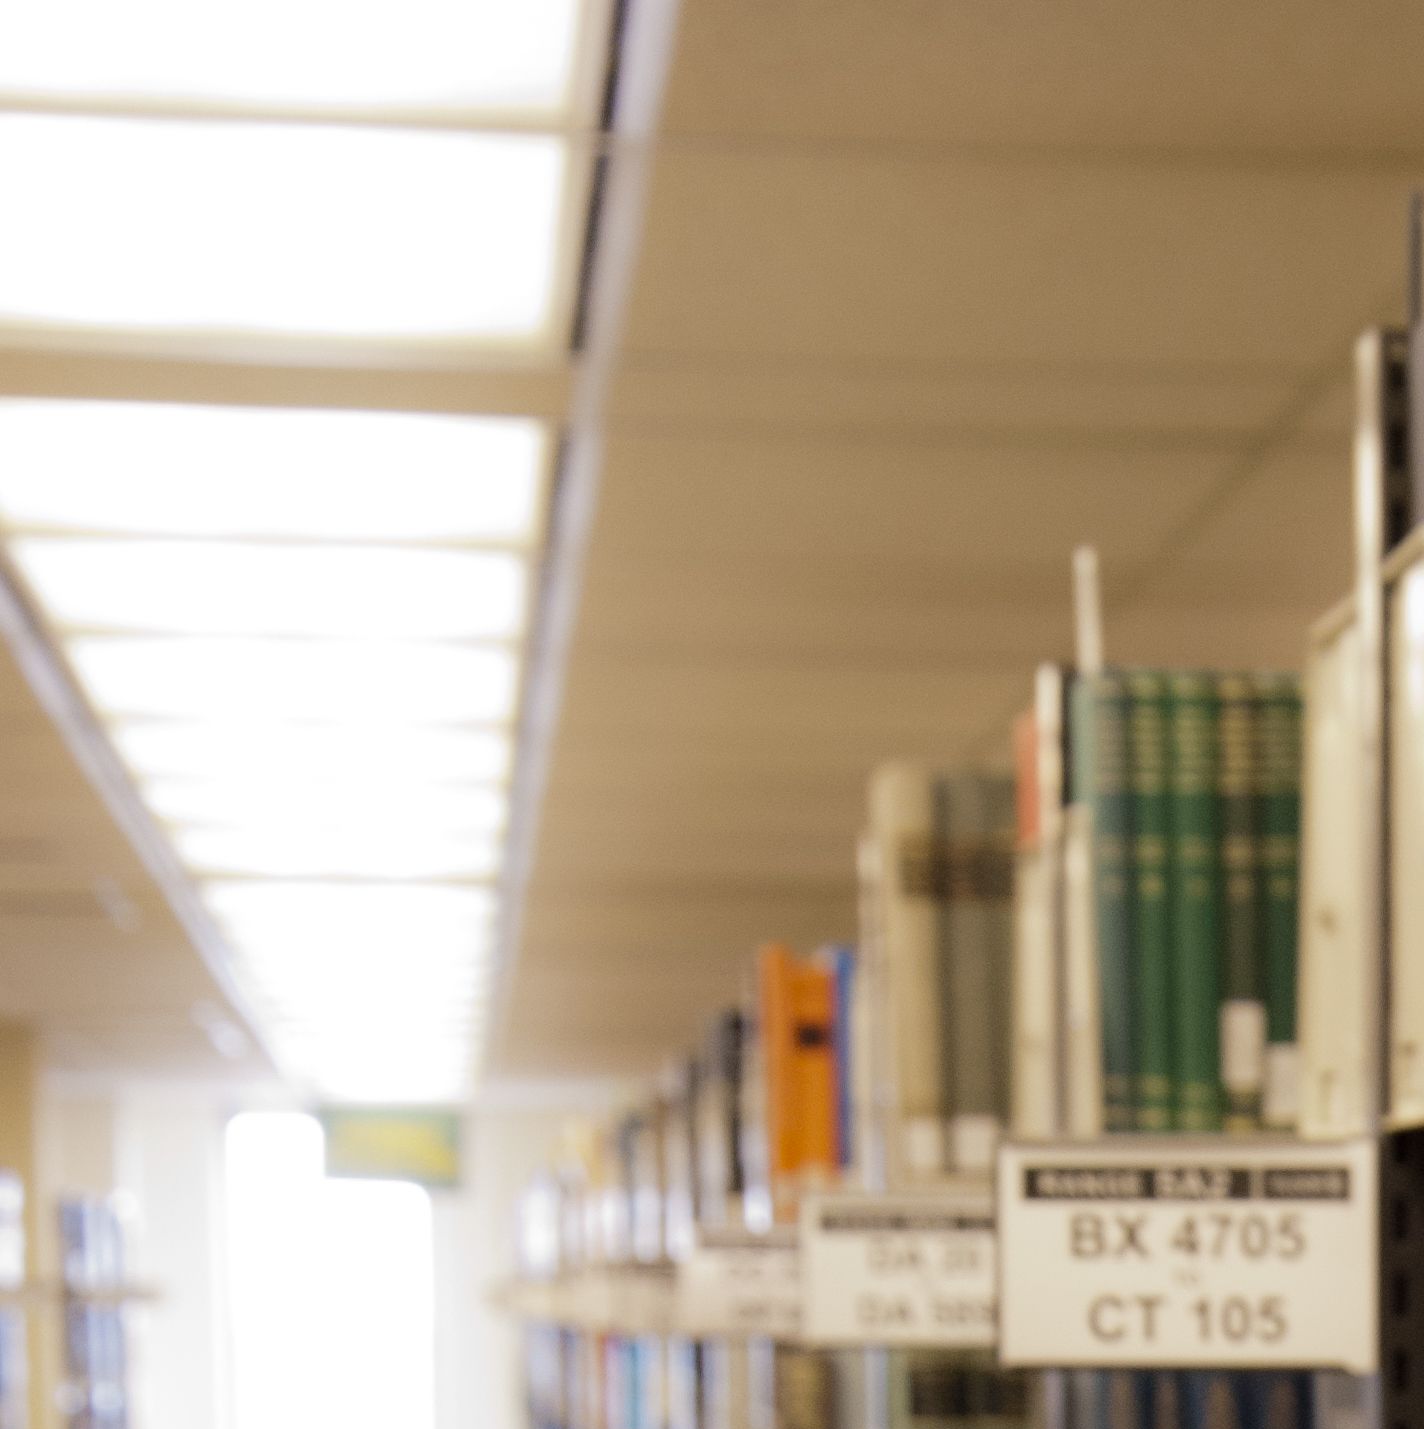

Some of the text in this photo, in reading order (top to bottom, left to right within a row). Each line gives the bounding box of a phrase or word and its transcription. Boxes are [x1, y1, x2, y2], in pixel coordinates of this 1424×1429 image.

[1069, 1212, 1308, 1261] BX 4705
[1087, 1293, 1289, 1345] CT 105
